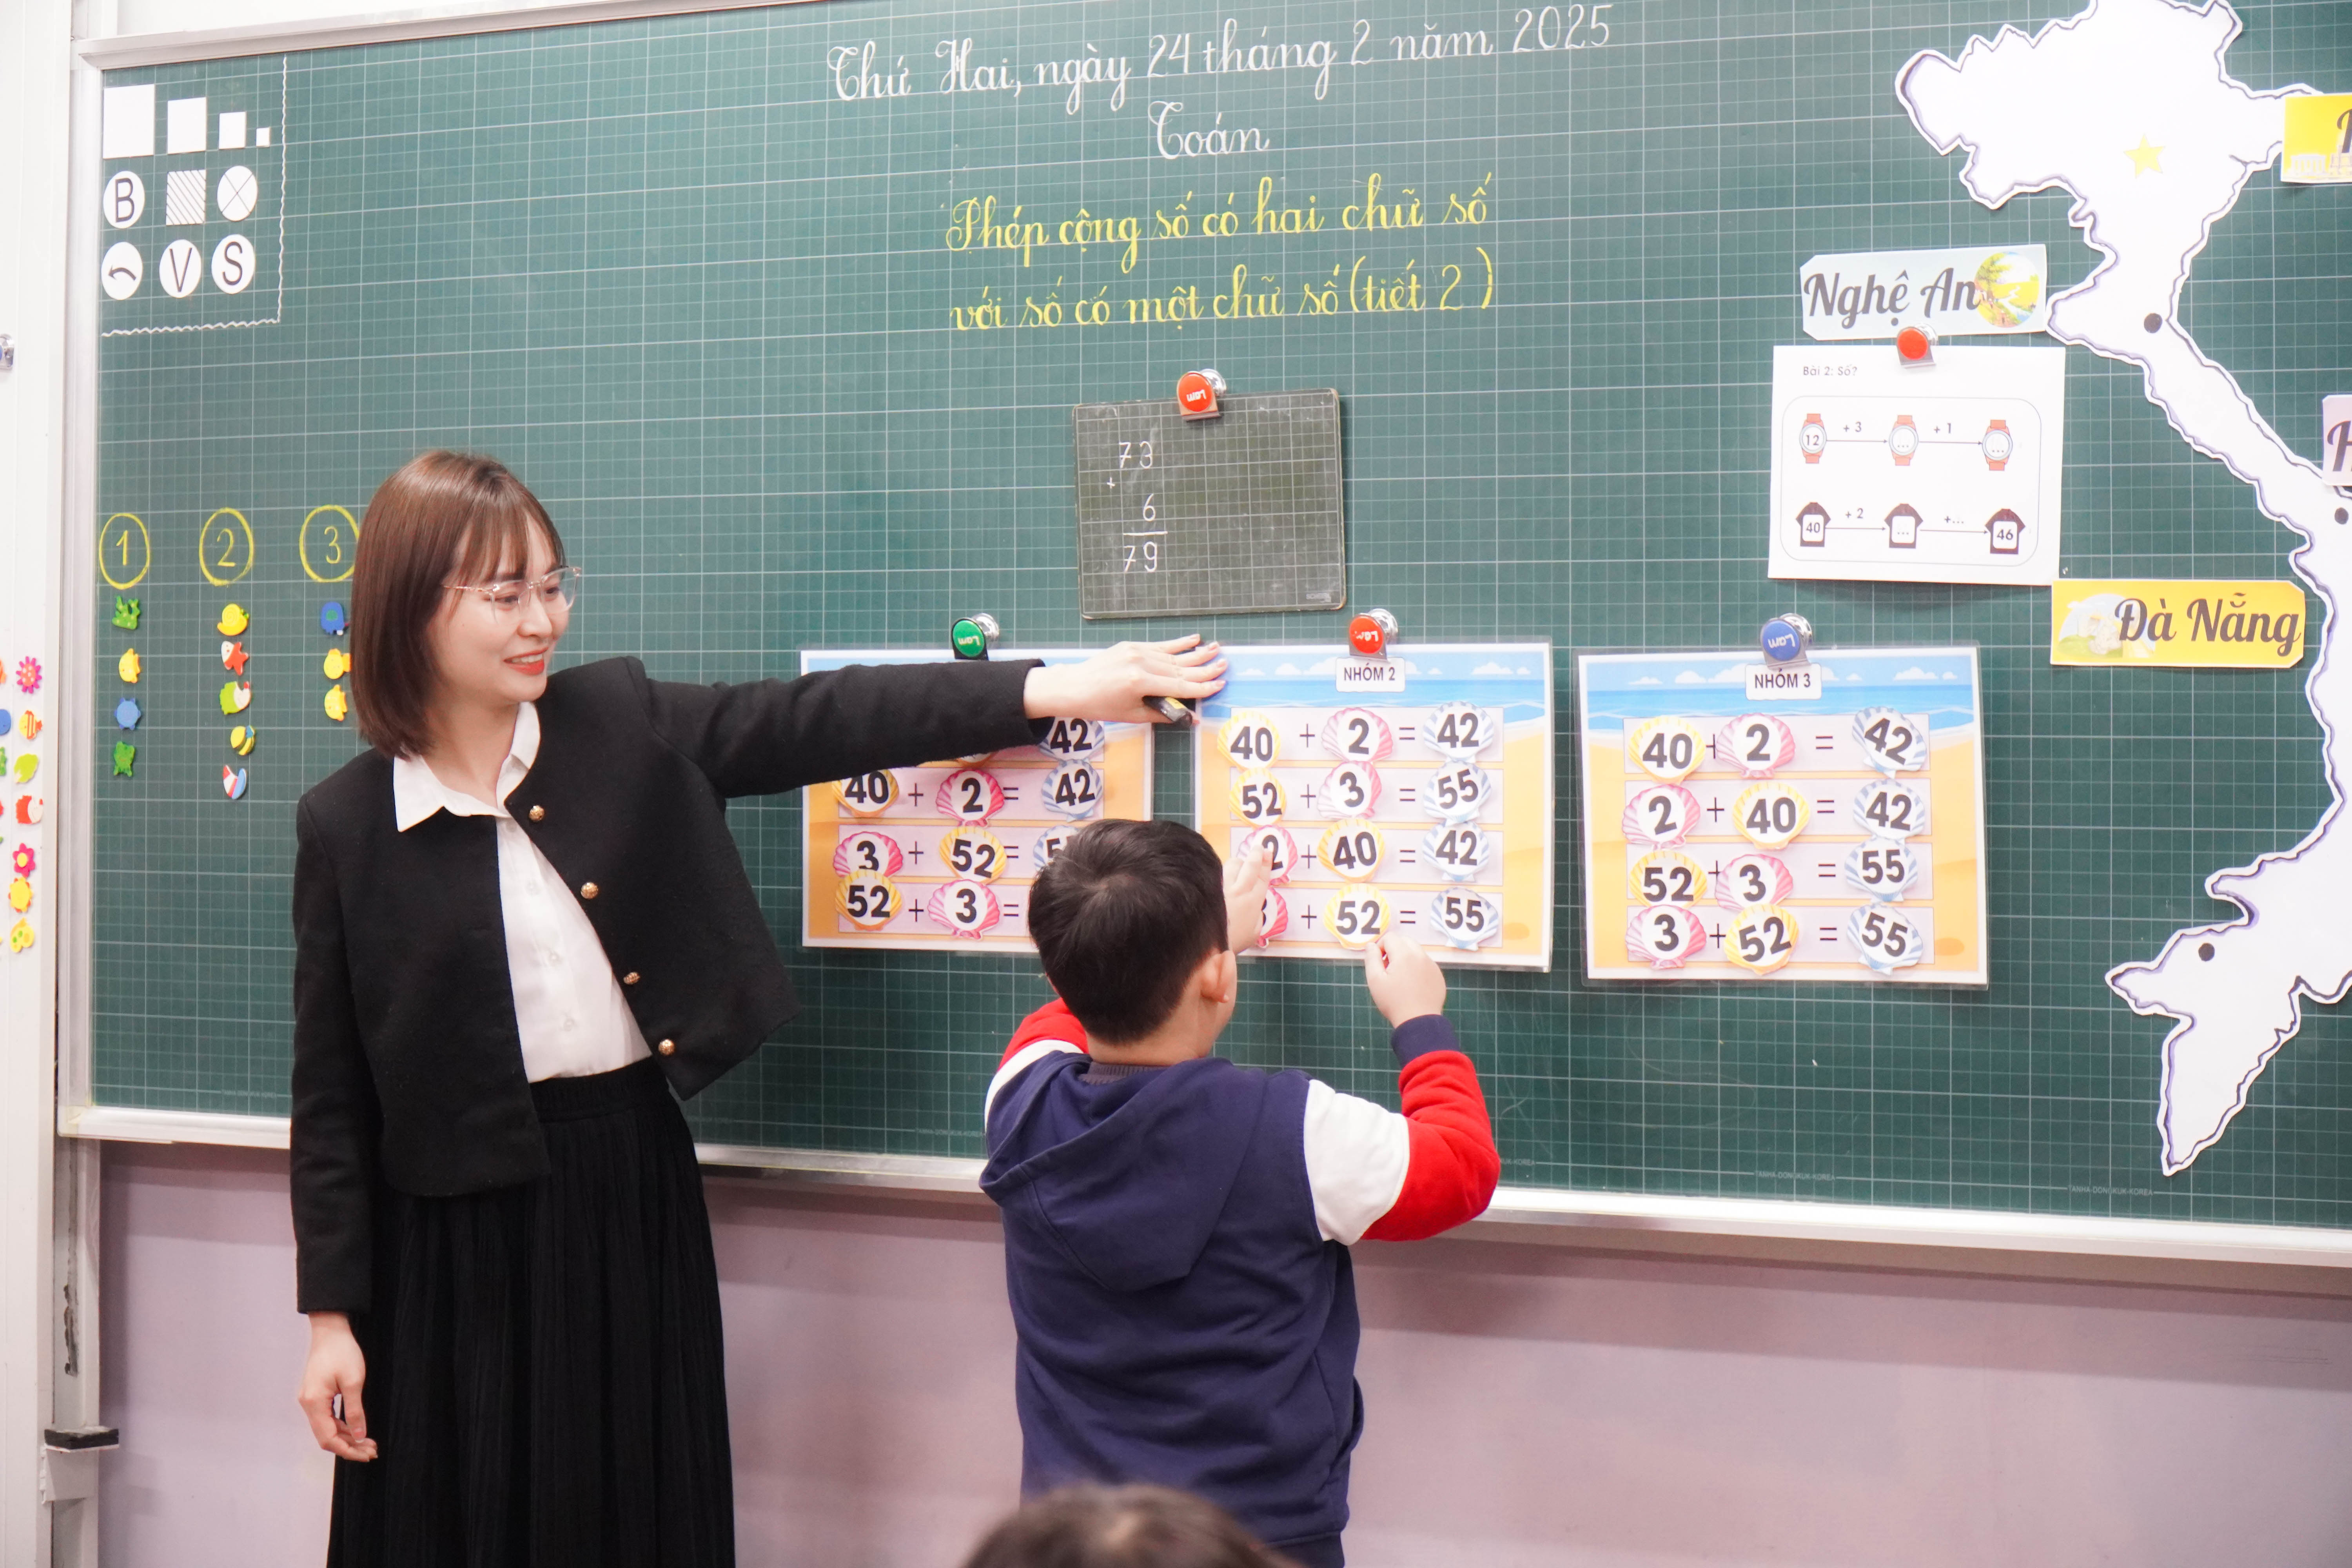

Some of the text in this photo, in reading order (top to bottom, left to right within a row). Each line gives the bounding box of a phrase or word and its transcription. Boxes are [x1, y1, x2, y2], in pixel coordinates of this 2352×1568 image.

[827, 4, 1614, 115] Thứ Hai, ngày 24 tháng 2 năm 2025
[1148, 100, 1270, 159] Toán
[115, 178, 135, 223] B
[946, 171, 1492, 273] Phép cộng số có hai chữ số
[169, 241, 243, 292] V S
[950, 286, 1008, 330] với
[1019, 276, 1063, 328] số
[1075, 285, 1110, 325] có
[1123, 285, 1204, 330] một
[1213, 264, 1285, 319] chữ
[1297, 263, 1341, 316] số
[1350, 255, 1426, 312] (tiết
[1804, 267, 1981, 329] Nghệ An
[1803, 364, 1858, 377] Bài 2: Số?
[1119, 441, 1153, 469] 73
[1806, 435, 1819, 446] 12
[1855, 421, 1862, 432] 3
[1947, 423, 1951, 433] 1
[1143, 493, 1156, 522] 6
[1806, 522, 1820, 533] 40
[1857, 508, 1863, 519] 2
[1996, 529, 2013, 540] 46
[116, 526, 341, 567] 1 2 3
[1123, 541, 1158, 573] 79
[2114, 592, 2301, 657] Đà Nẵng
[1344, 662, 1395, 681] NHÓM 2
[1755, 667, 1811, 688] NHÓM 3
[1050, 718, 1093, 753] 42
[1230, 726, 1272, 762] 40
[1348, 718, 1369, 755] 2
[1437, 712, 1479, 748] 42
[1642, 733, 1692, 769] 40
[1746, 724, 1770, 761] 2
[1864, 718, 1913, 765] 42
[844, 771, 889, 804] 40
[961, 777, 983, 813] 2
[1055, 768, 1096, 806] 42
[1243, 782, 1283, 819] 52
[1339, 771, 1364, 808] 3
[1438, 768, 1479, 809] 55
[1648, 796, 1677, 835] 2
[1746, 797, 1796, 834] 40
[1866, 791, 1912, 831] 42
[857, 840, 879, 871] 3
[951, 838, 995, 878] 52
[1262, 835, 1283, 871] 2
[1333, 831, 1377, 869] 40
[1436, 830, 1477, 866] 42
[1643, 867, 1694, 902] 52
[1739, 864, 1766, 902] 3
[1862, 849, 1905, 884] 55
[846, 885, 890, 918] 52
[956, 888, 977, 924] 3
[1336, 900, 1380, 935] 52
[1445, 897, 1484, 932] 55
[1654, 914, 1679, 951] 3
[1739, 916, 1792, 962] 52
[1862, 912, 1908, 957] 55
